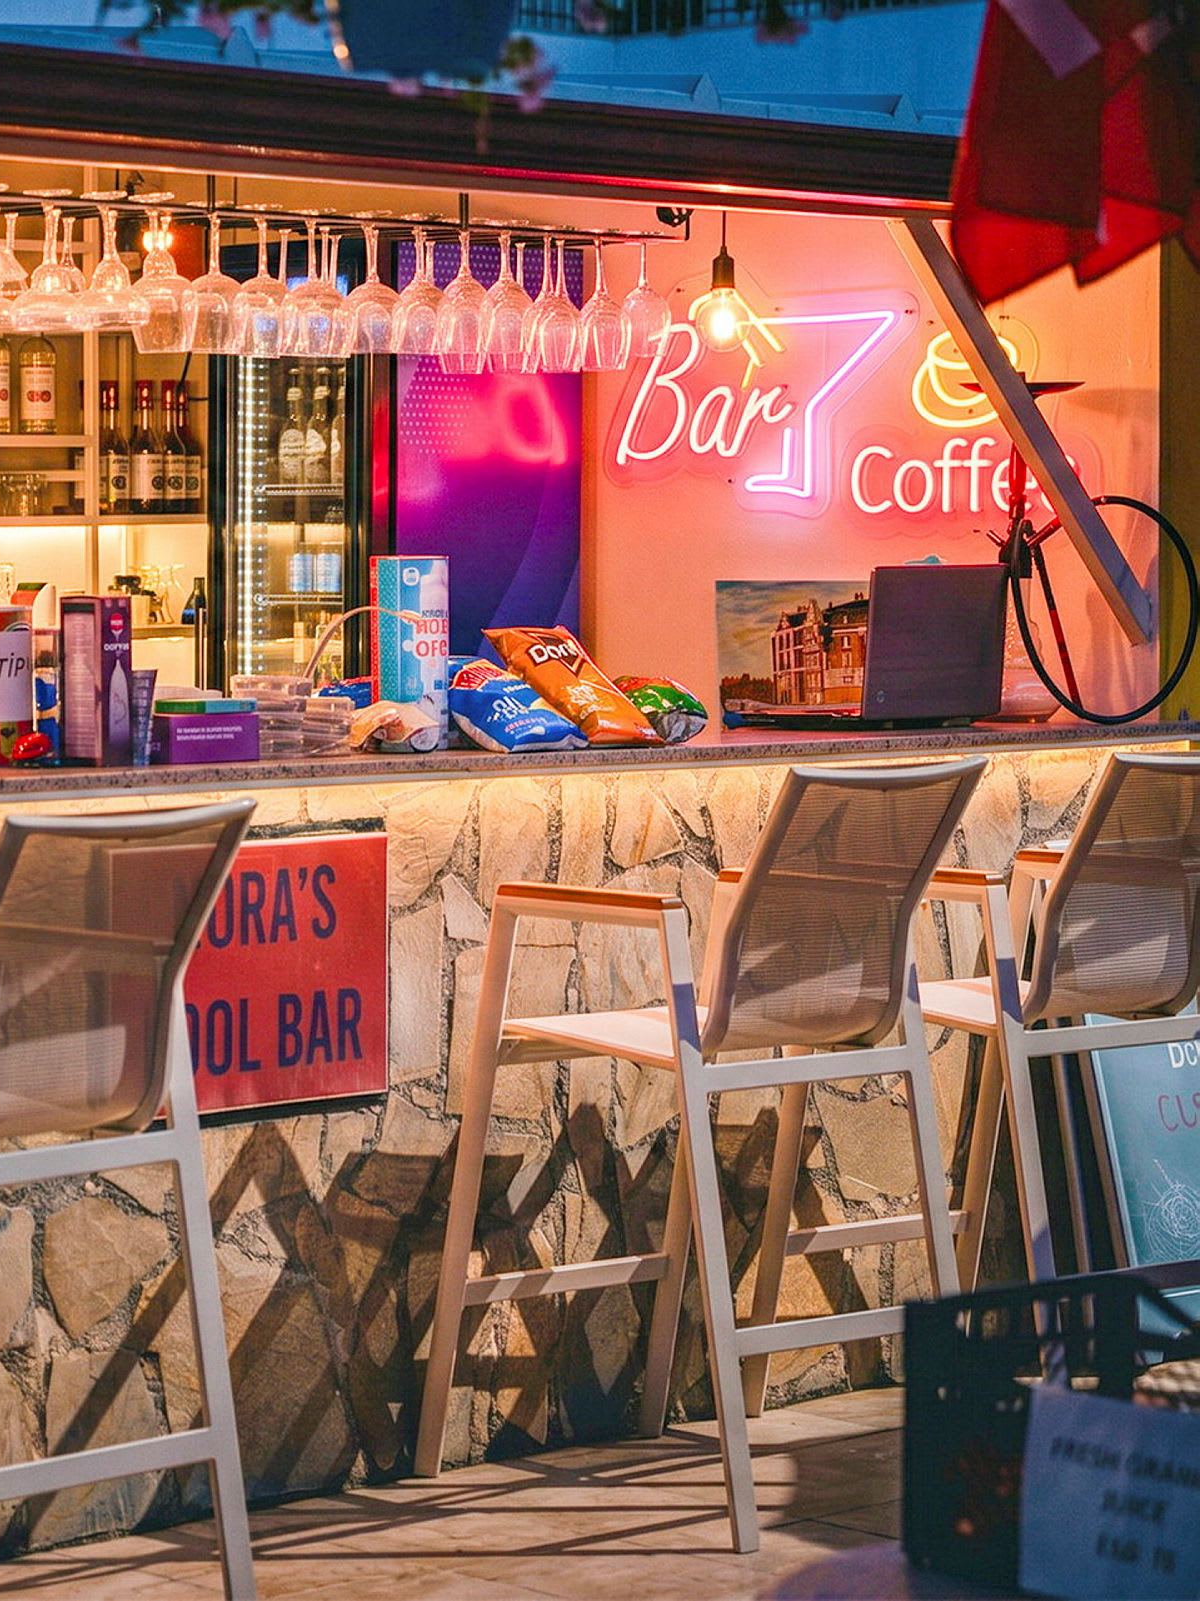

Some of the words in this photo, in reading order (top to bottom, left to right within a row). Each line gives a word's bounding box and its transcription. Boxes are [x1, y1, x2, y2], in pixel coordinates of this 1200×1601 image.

[616, 320, 795, 465] Bar
[850, 437, 1076, 514] Coffe
[198, 863, 338, 950] ORA'S
[277, 988, 363, 1069] BAR
